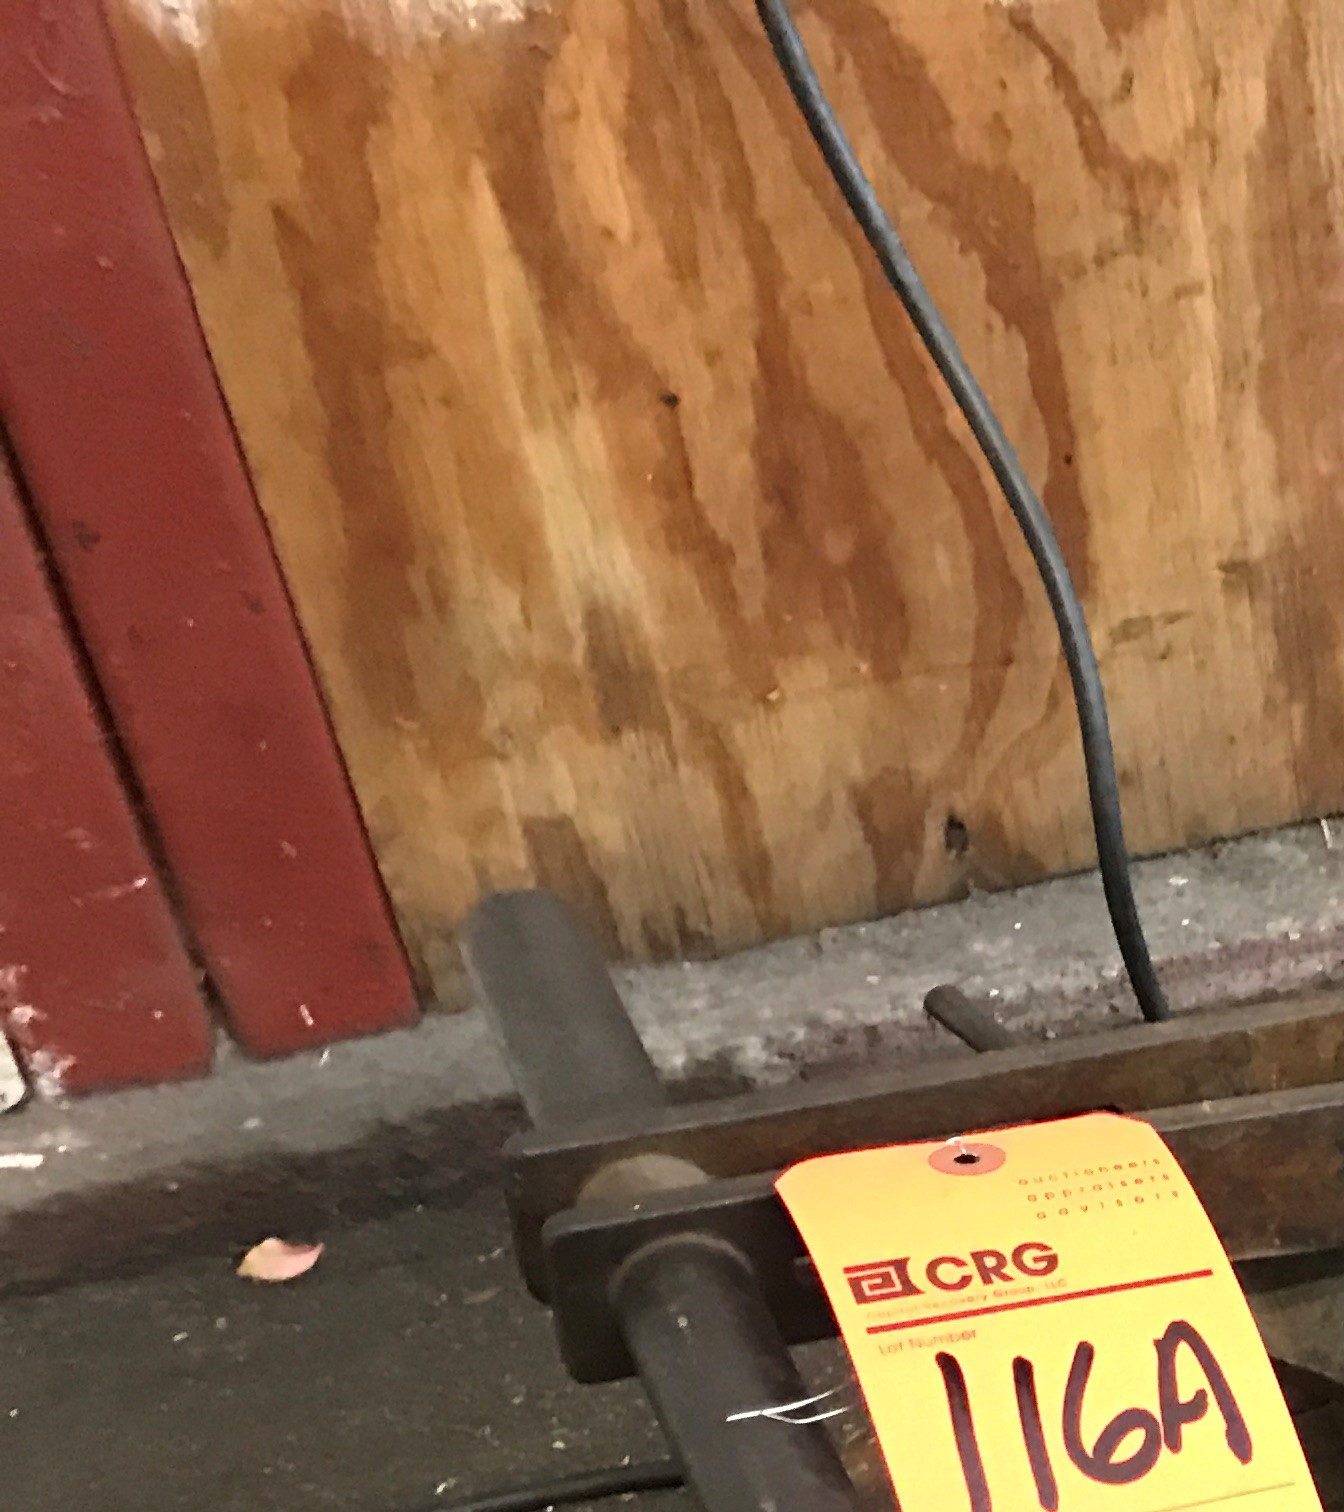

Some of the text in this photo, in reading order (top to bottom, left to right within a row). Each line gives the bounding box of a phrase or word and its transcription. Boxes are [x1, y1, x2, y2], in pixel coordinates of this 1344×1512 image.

[1018, 1157, 1161, 1186] auctioneers
[925, 1241, 1059, 1292] CRG
[877, 1328, 977, 1356] Lot Number
